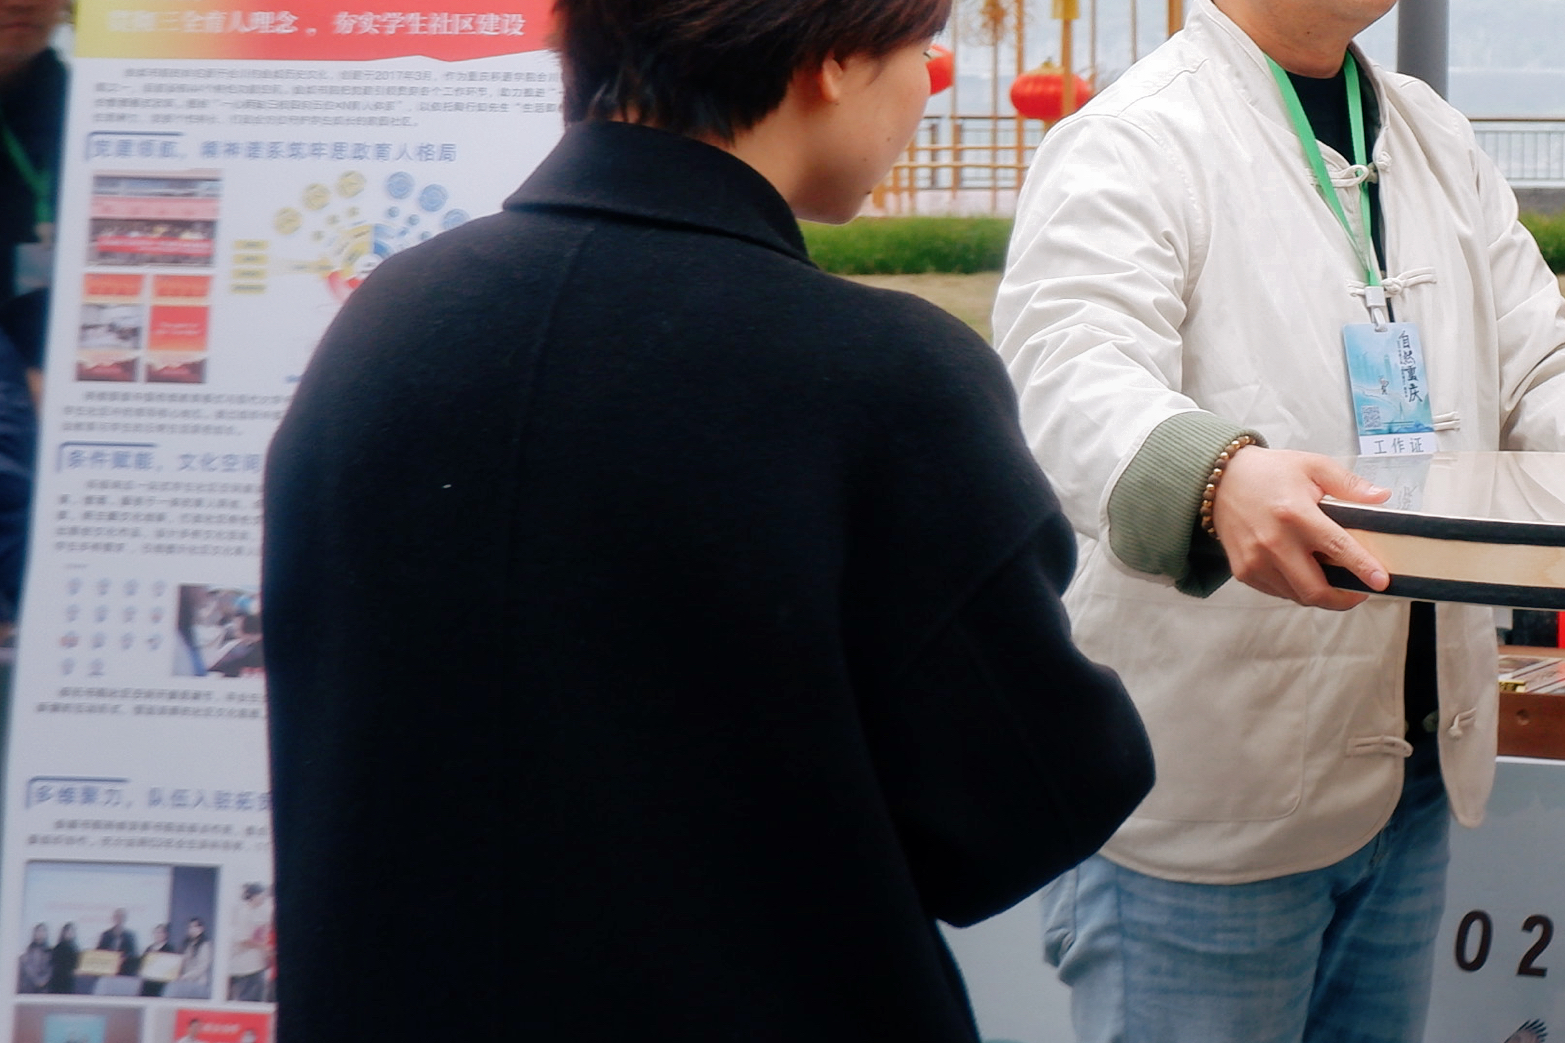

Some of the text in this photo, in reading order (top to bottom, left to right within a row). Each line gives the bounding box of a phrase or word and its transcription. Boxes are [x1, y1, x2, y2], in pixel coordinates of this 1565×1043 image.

[1398, 330, 1423, 402] 自然重庆
[1374, 437, 1424, 455] 工作证
